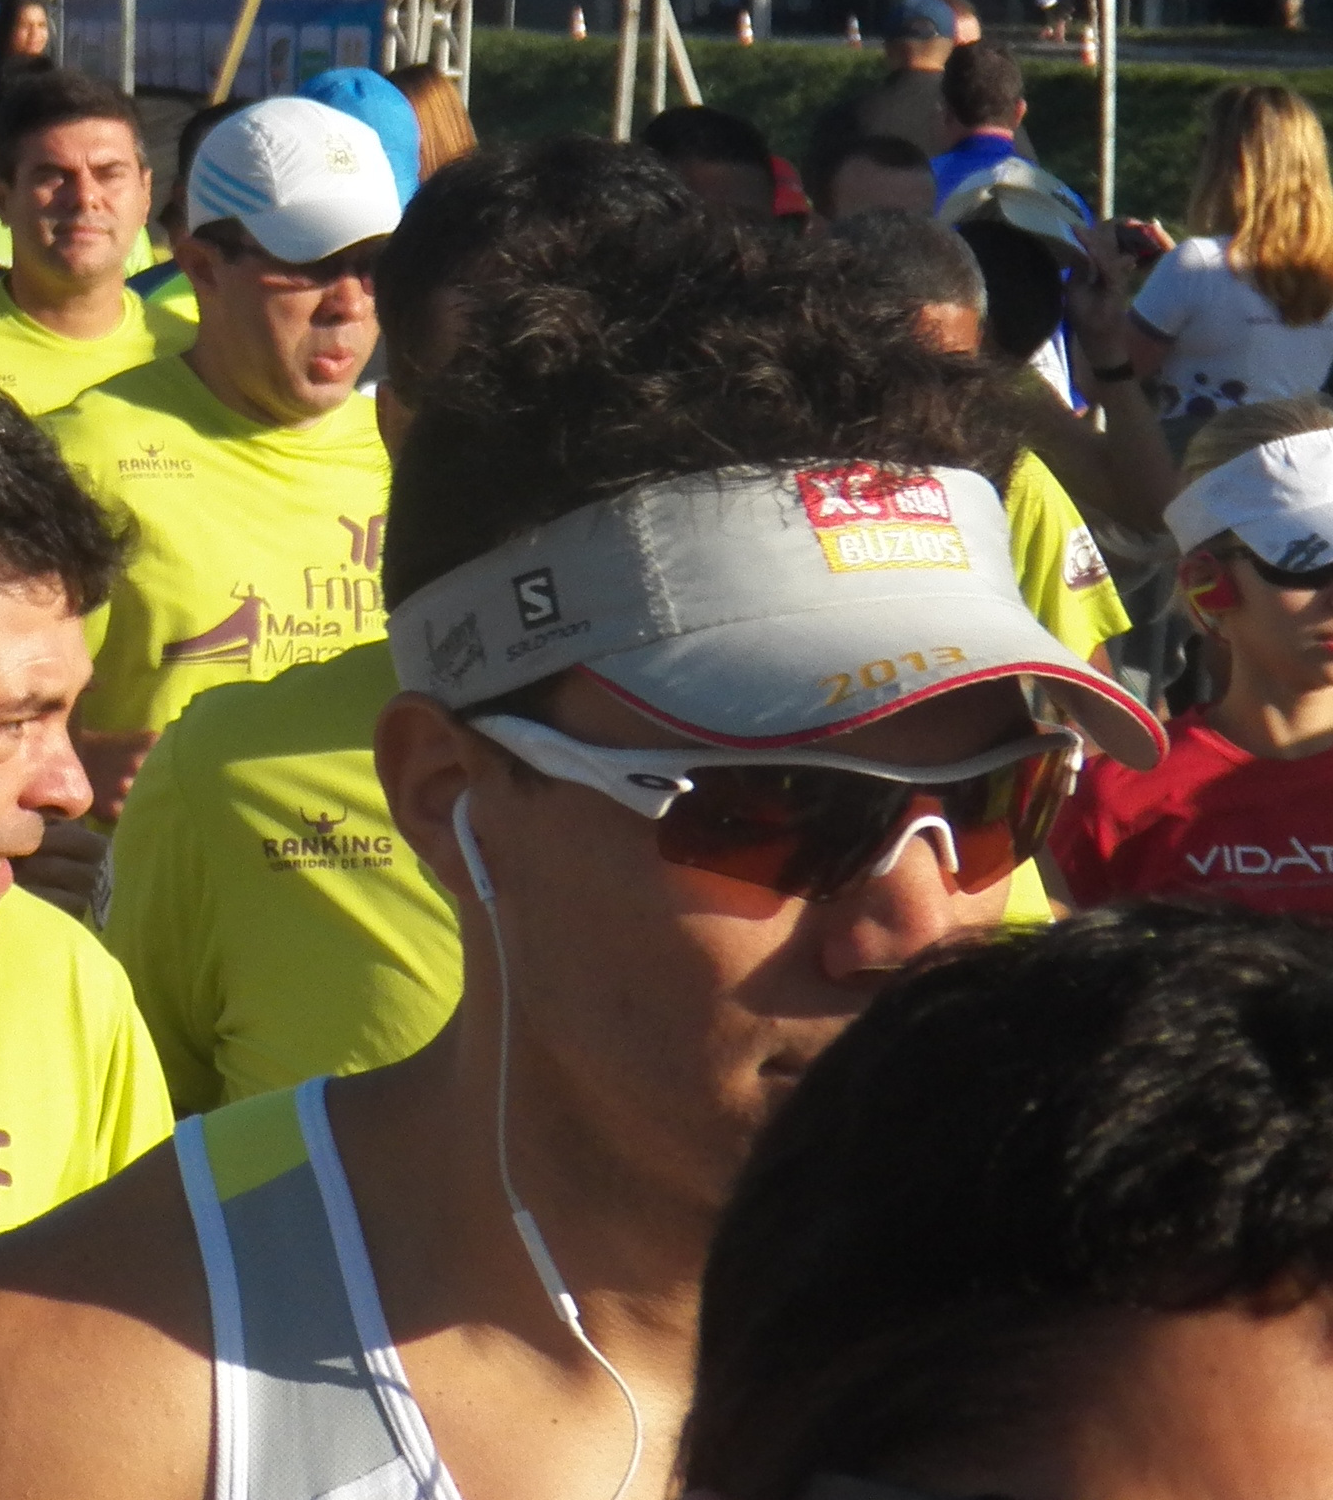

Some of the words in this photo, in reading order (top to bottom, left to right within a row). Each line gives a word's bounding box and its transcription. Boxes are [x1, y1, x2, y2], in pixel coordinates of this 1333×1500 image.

[118, 459, 192, 473] RANKING
[266, 614, 342, 637] Meia
[818, 646, 967, 707] 2013
[261, 834, 393, 858] RANKING
[341, 857, 359, 870] DE
